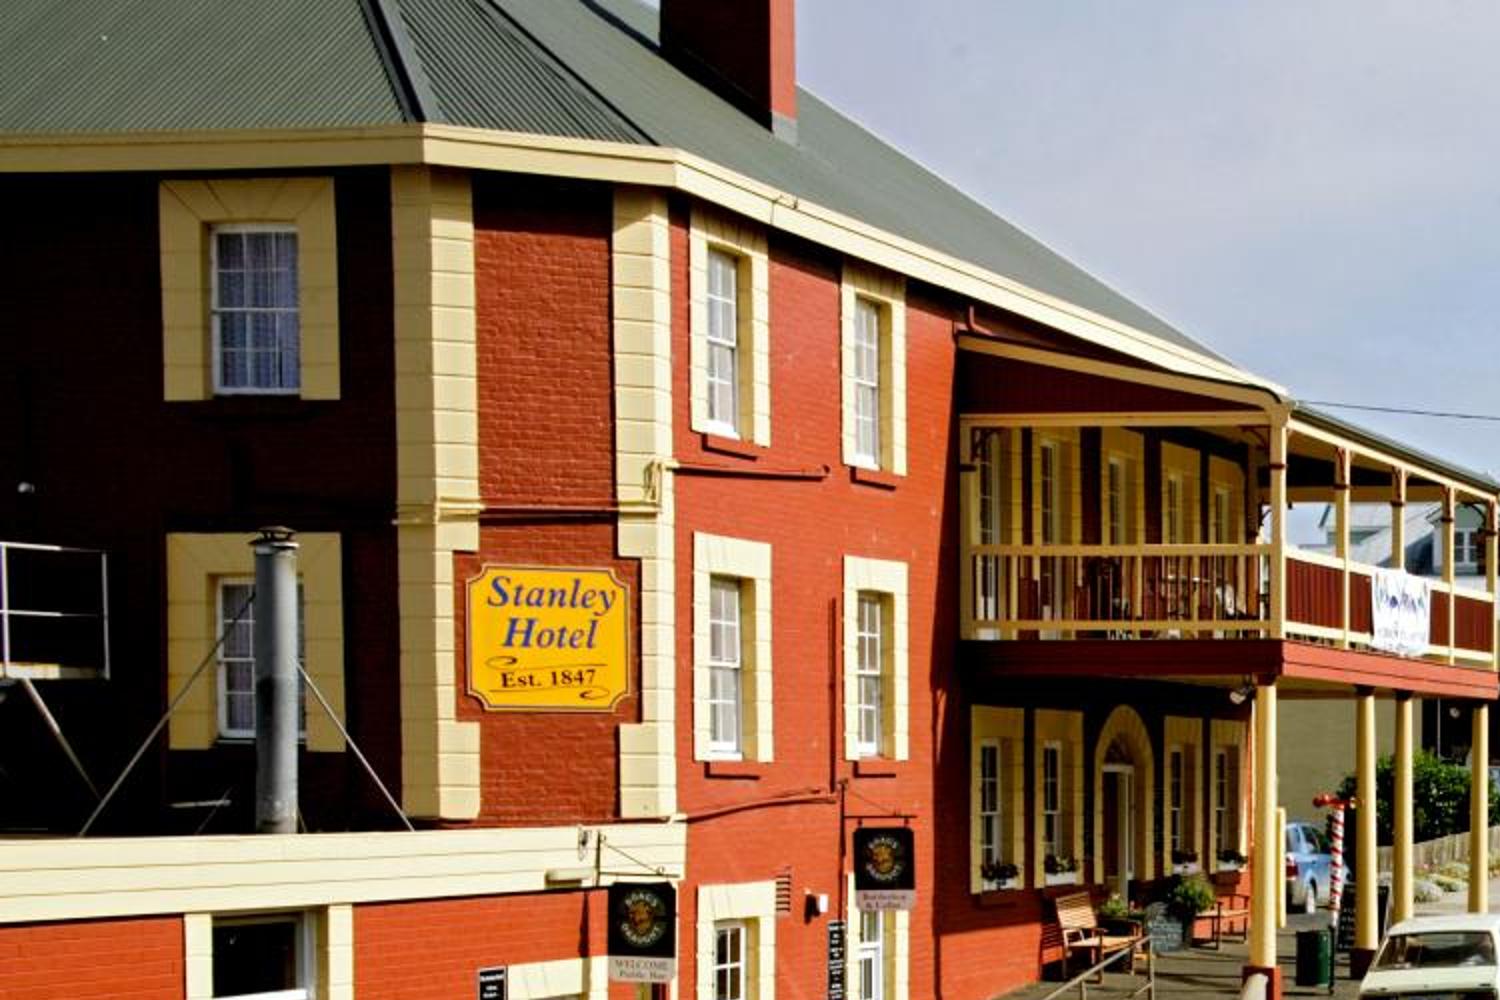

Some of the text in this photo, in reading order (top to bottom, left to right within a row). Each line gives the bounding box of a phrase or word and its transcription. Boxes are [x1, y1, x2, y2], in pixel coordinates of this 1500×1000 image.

[487, 575, 616, 616] Stanley
[502, 617, 598, 649] Hotel
[501, 669, 596, 688] Est. 1847
